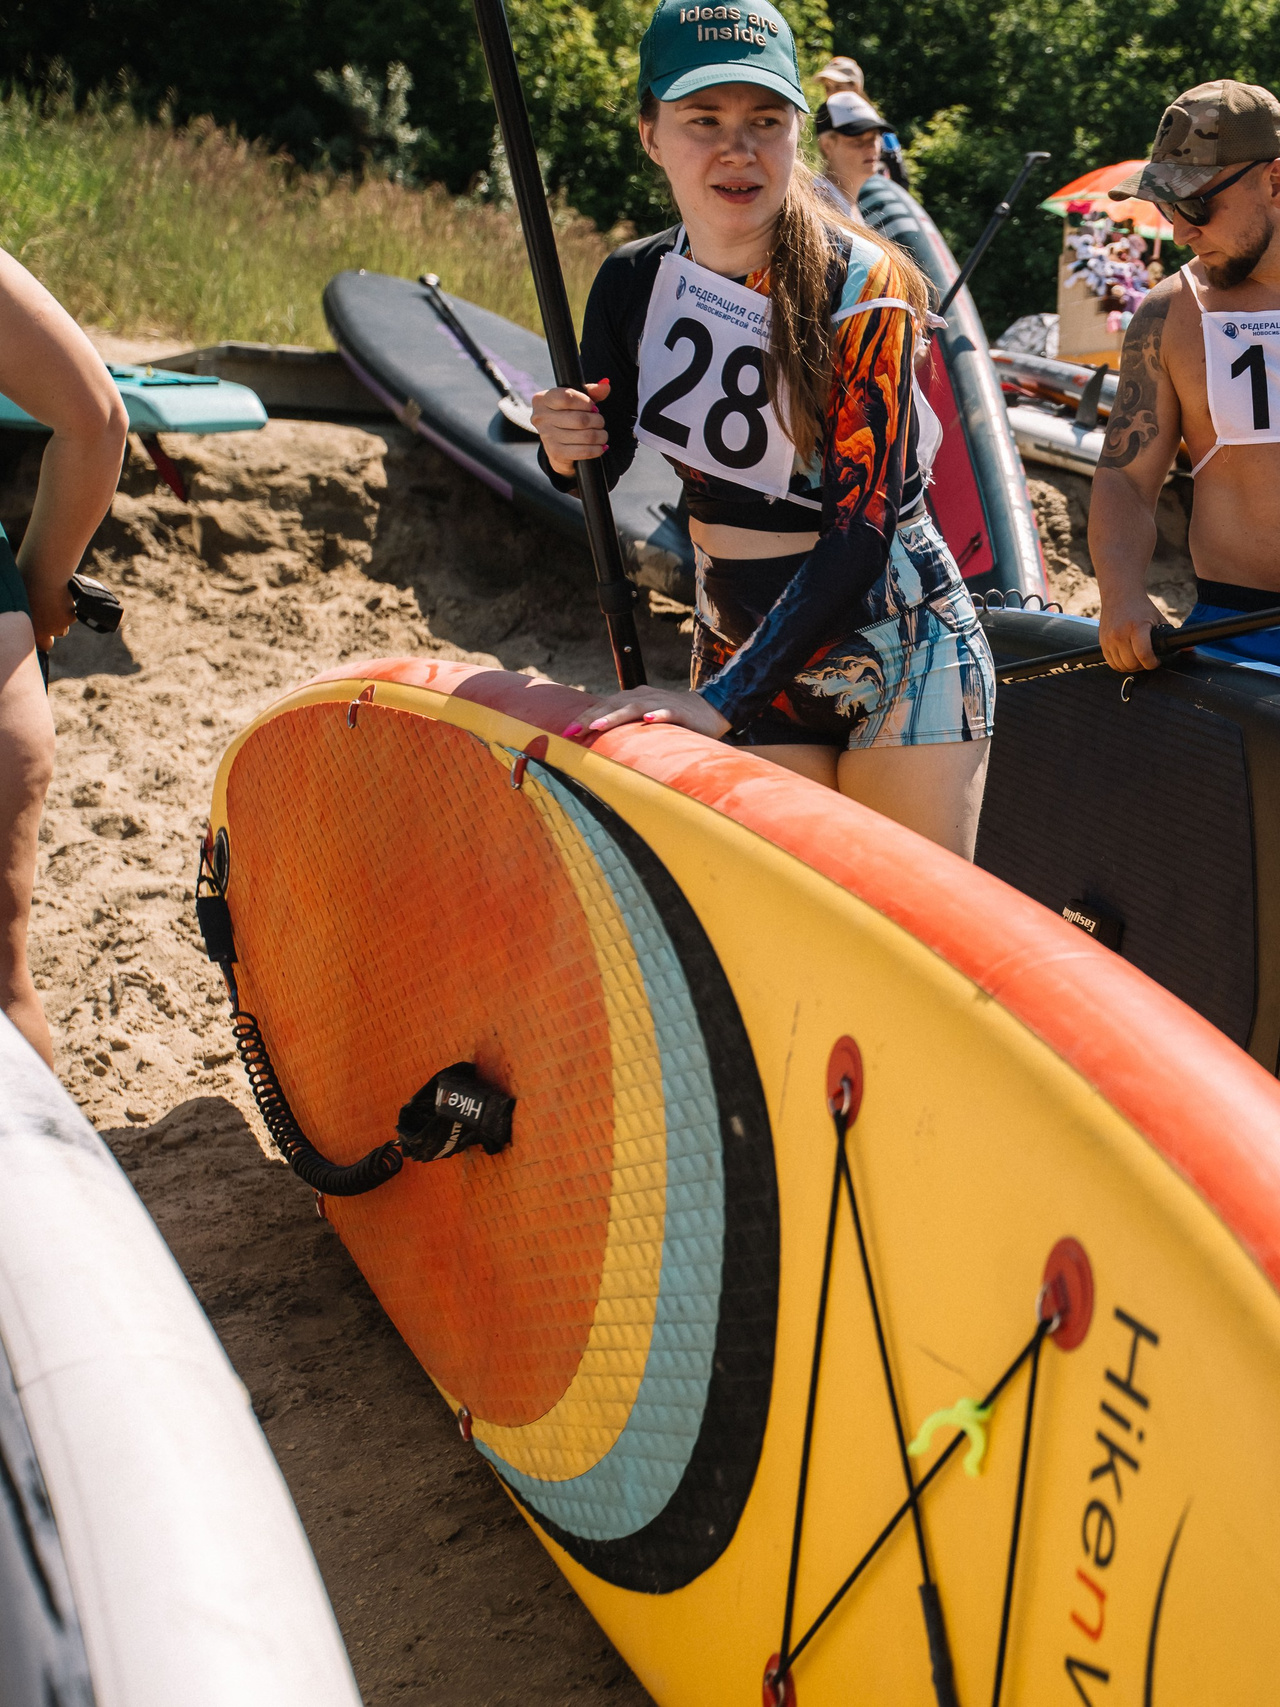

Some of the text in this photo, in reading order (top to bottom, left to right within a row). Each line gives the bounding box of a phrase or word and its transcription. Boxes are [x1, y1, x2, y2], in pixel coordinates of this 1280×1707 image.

[680, 5, 779, 34] ideas are
[697, 23, 767, 47] inside
[688, 284, 747, 317] ФЕДЕРАЦИЯ
[695, 301, 750, 330] НОВОСИБИРСКОЙ
[638, 316, 772, 470] 28
